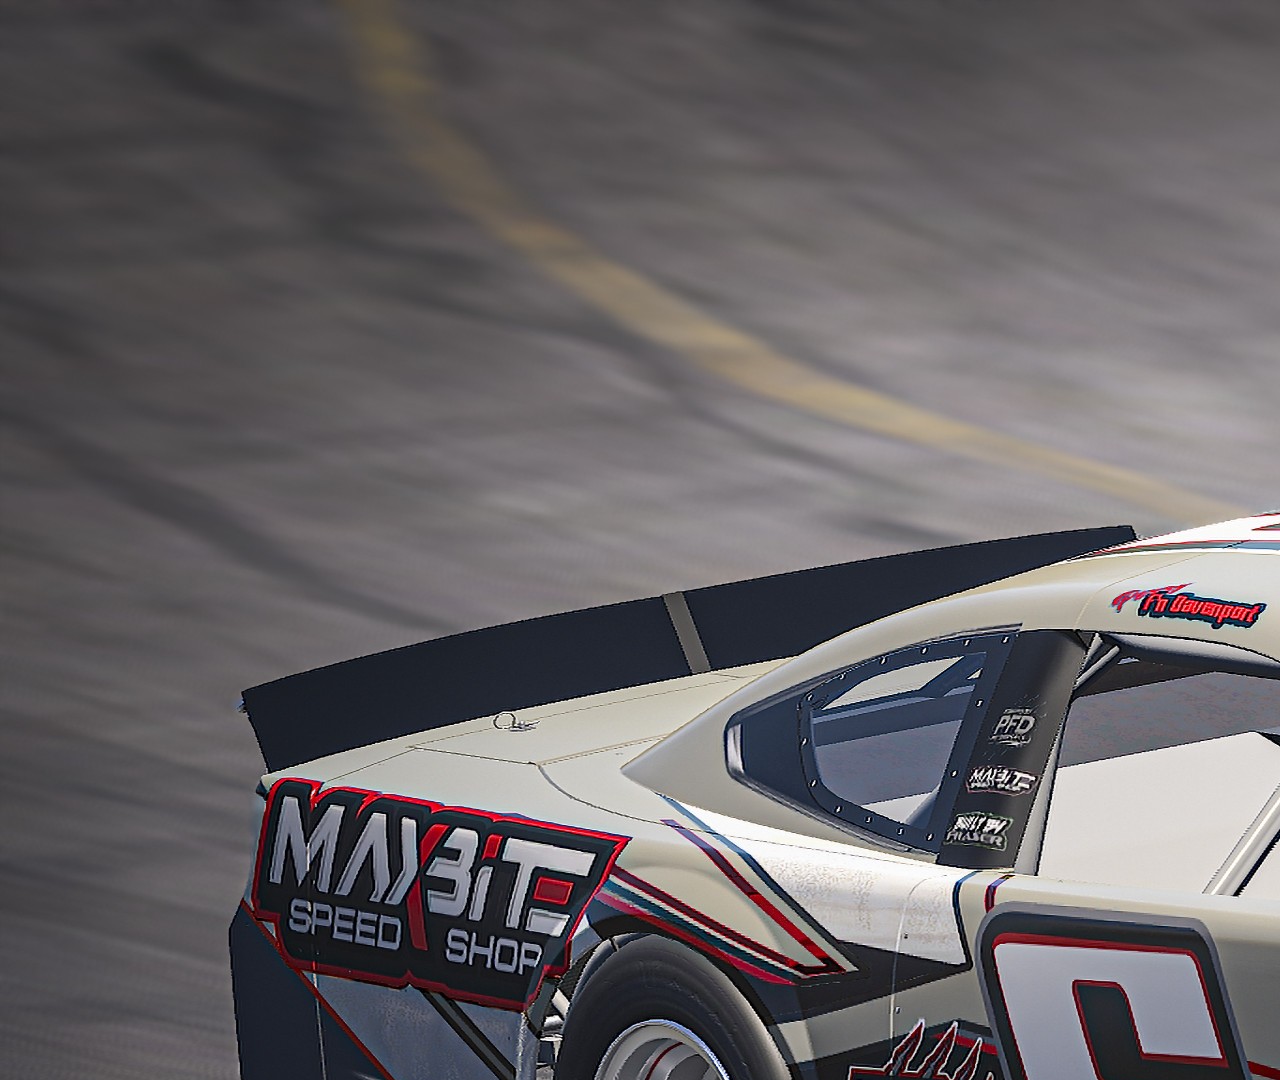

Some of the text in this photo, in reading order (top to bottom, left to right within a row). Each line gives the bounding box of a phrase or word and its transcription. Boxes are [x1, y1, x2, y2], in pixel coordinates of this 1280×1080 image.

[1170, 595, 1261, 623] Davenport
[994, 715, 1035, 735] PFD
[288, 899, 542, 976] SPEED SHOP
